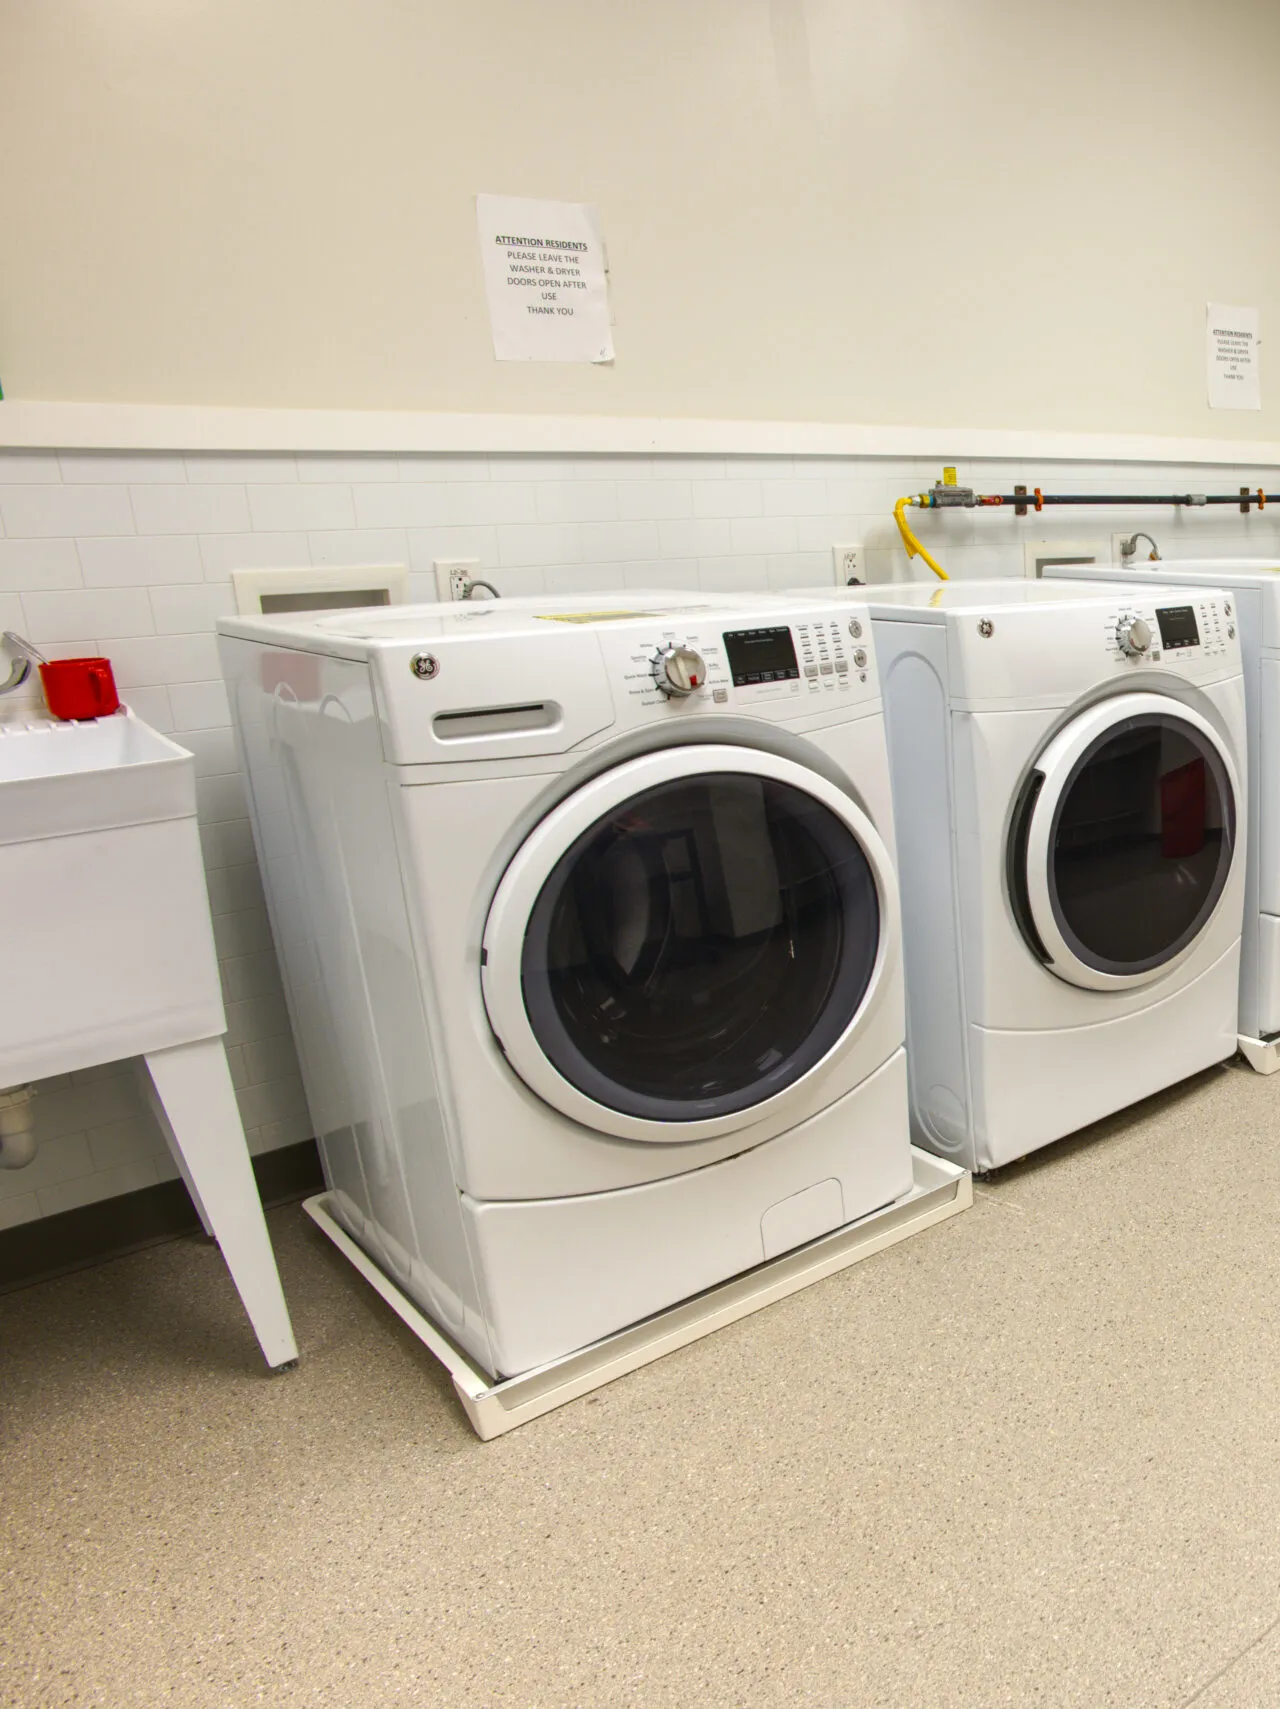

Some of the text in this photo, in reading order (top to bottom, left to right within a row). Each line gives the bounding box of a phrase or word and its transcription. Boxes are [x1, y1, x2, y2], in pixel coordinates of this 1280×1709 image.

[496, 235, 588, 250] ATTENTION RESIDENTS
[507, 251, 580, 264] PLEASE LEAVE THE
[509, 264, 581, 277] WASHER & DRYER
[507, 277, 587, 289] DOORS OPEN AFTER
[541, 292, 557, 301] USE
[527, 305, 574, 316] THANK YOU
